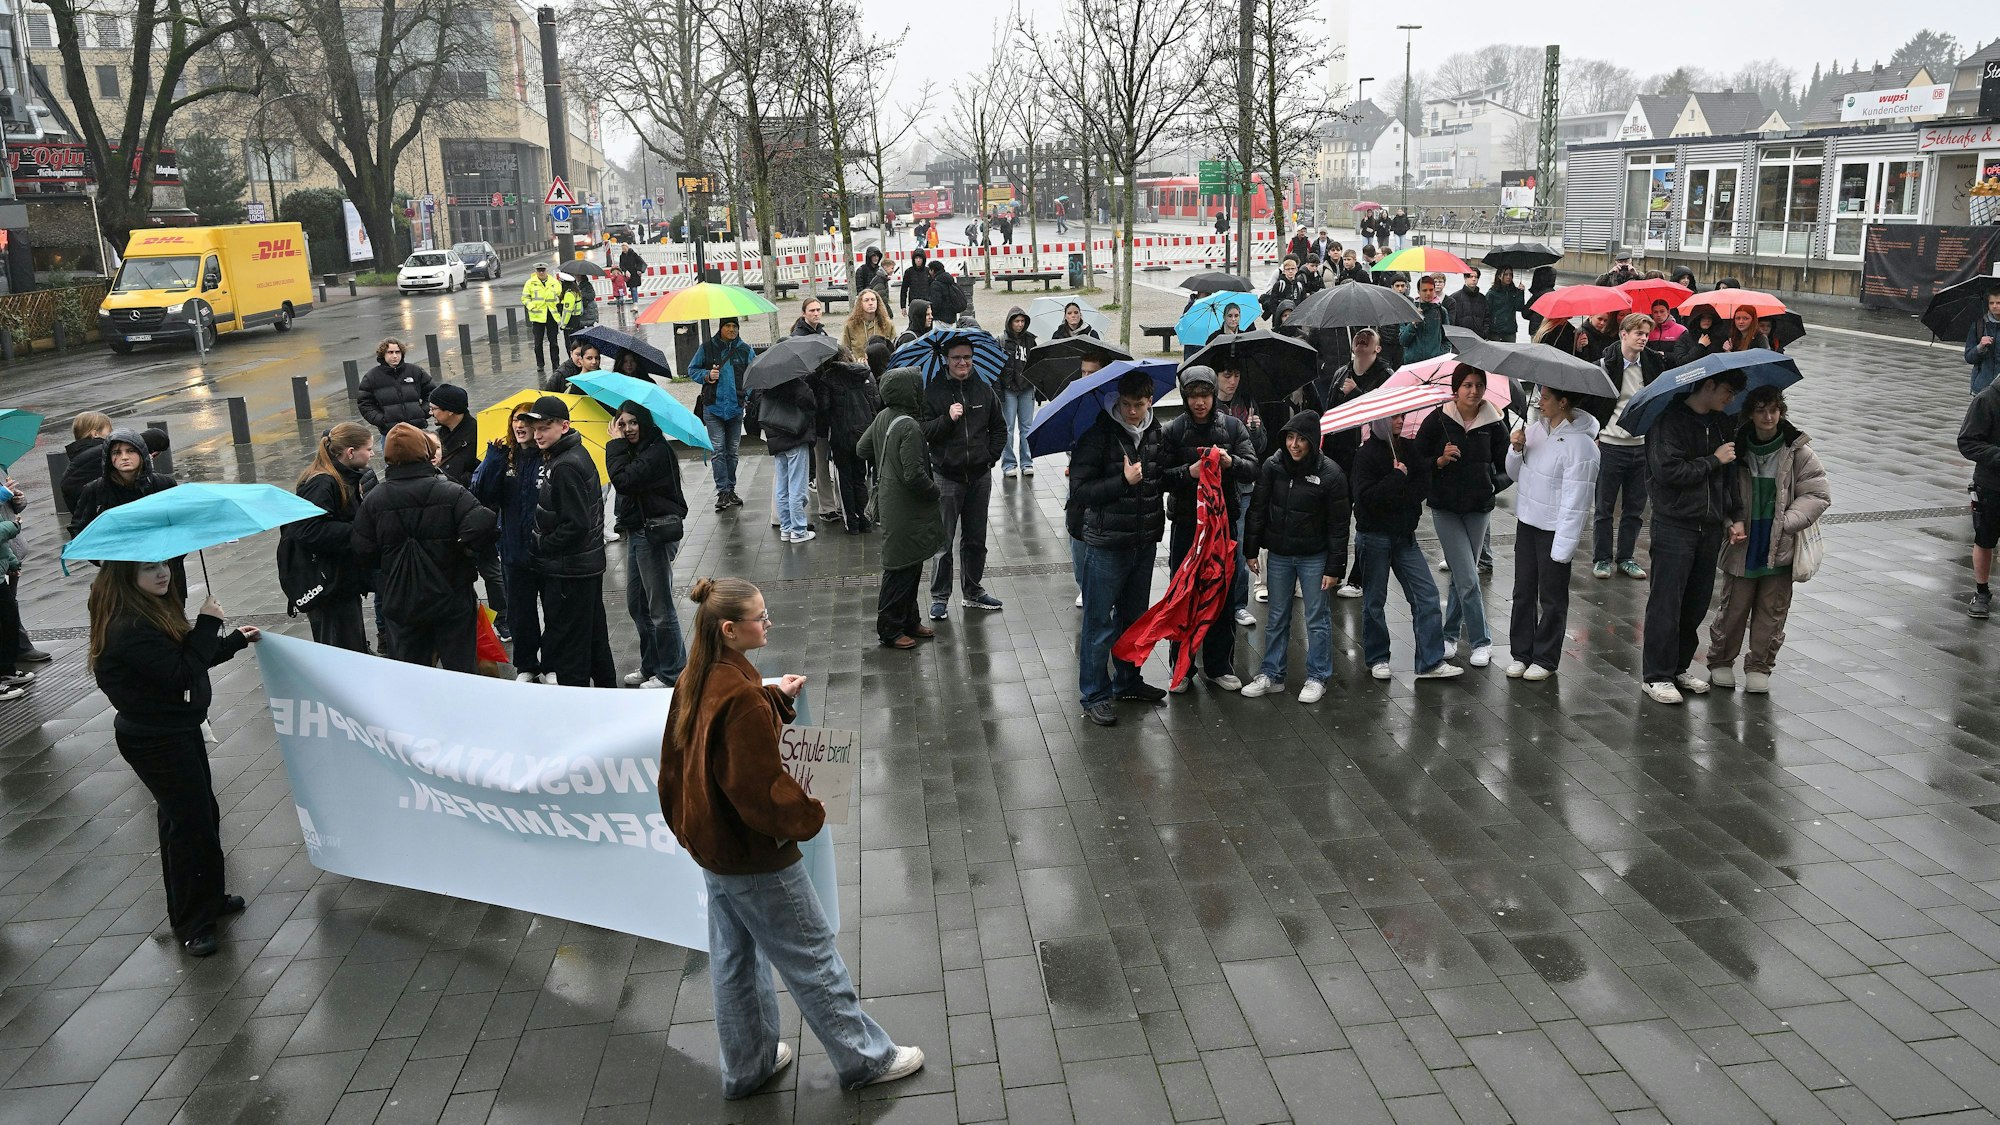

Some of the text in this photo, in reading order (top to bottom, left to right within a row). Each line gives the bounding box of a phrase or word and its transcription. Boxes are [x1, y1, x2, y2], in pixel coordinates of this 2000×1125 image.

[1878, 90, 1909, 104] wupsi
[1933, 90, 1944, 99] DB
[1862, 104, 1923, 116] KundenCenter
[1921, 127, 1993, 149] Stehcafe &
[143, 236, 186, 245] DHL
[258, 239, 295, 260] DHL
[296, 584, 324, 607] adidas
[781, 728, 825, 762] Schule
